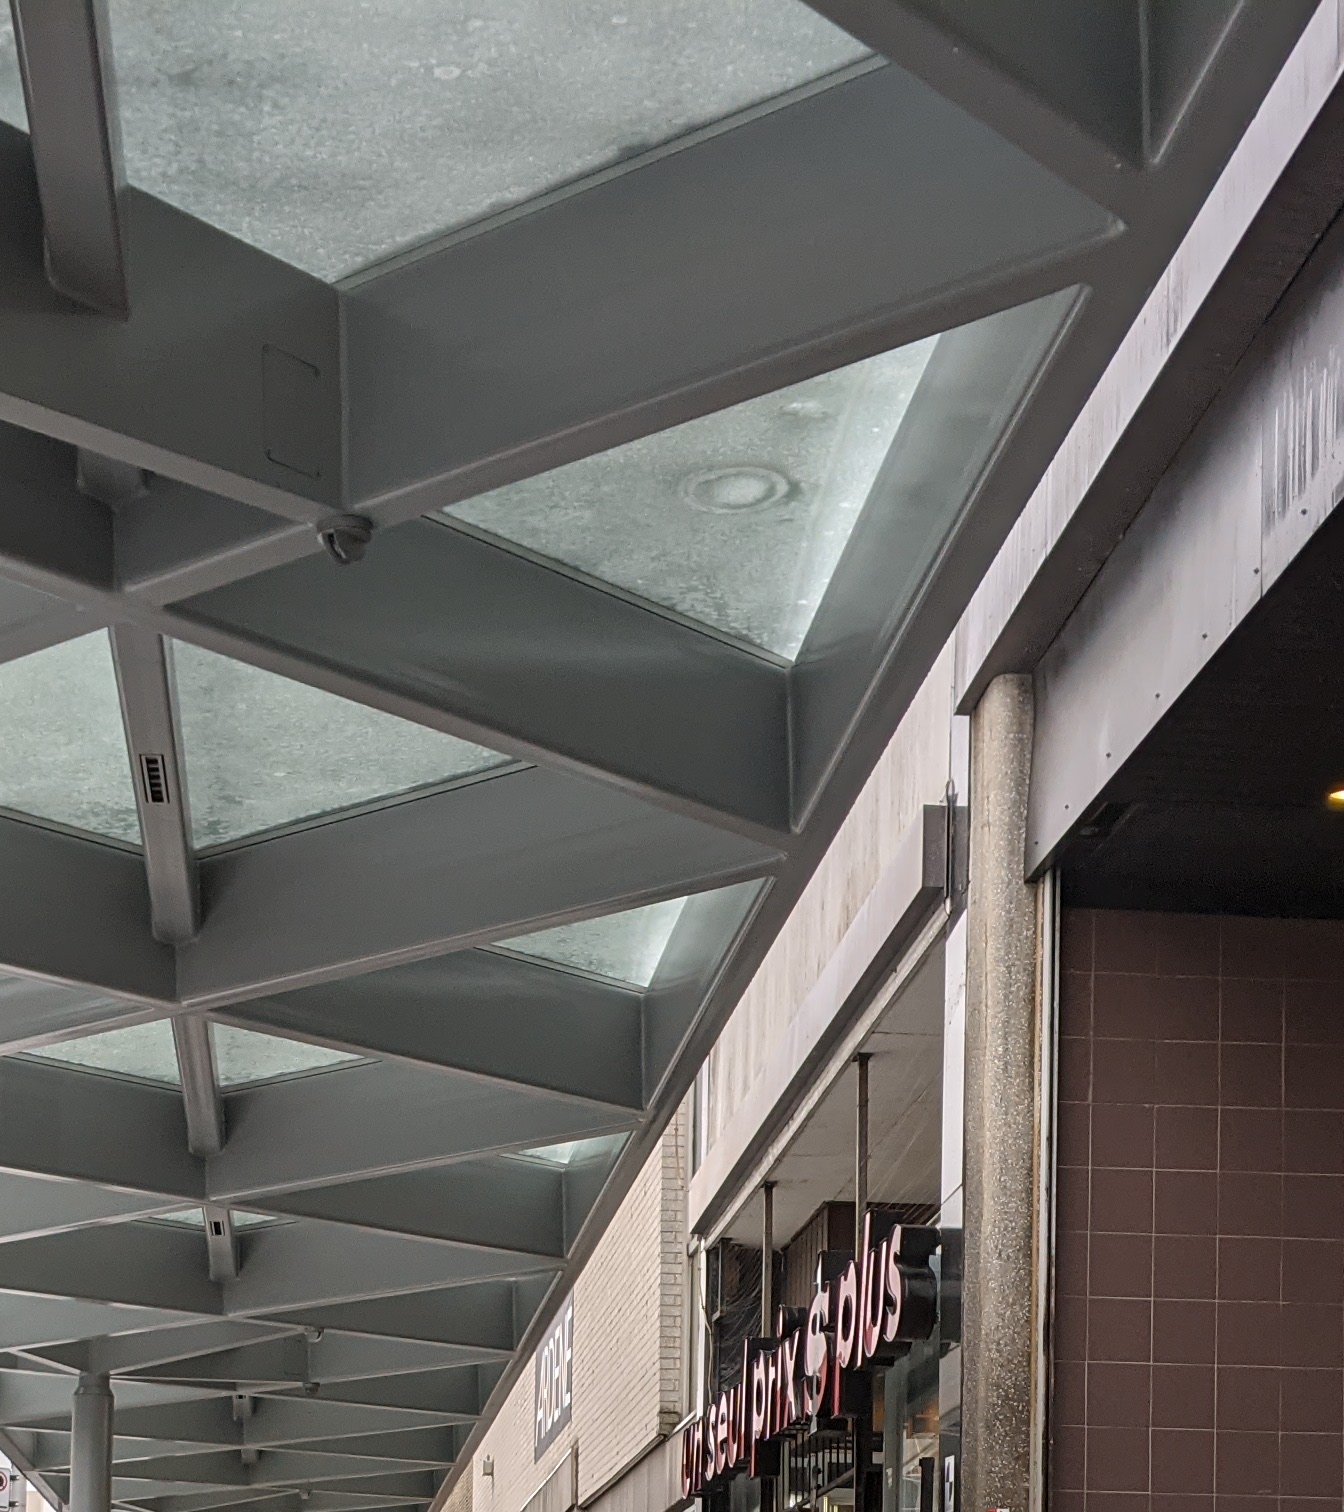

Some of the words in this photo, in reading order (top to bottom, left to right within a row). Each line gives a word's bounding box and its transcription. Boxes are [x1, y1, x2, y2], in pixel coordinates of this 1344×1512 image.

[535, 1305, 573, 1447] ARDENE
[705, 1336, 748, 1481] seul
[749, 1304, 801, 1480] prix
[831, 1210, 903, 1419] plus
